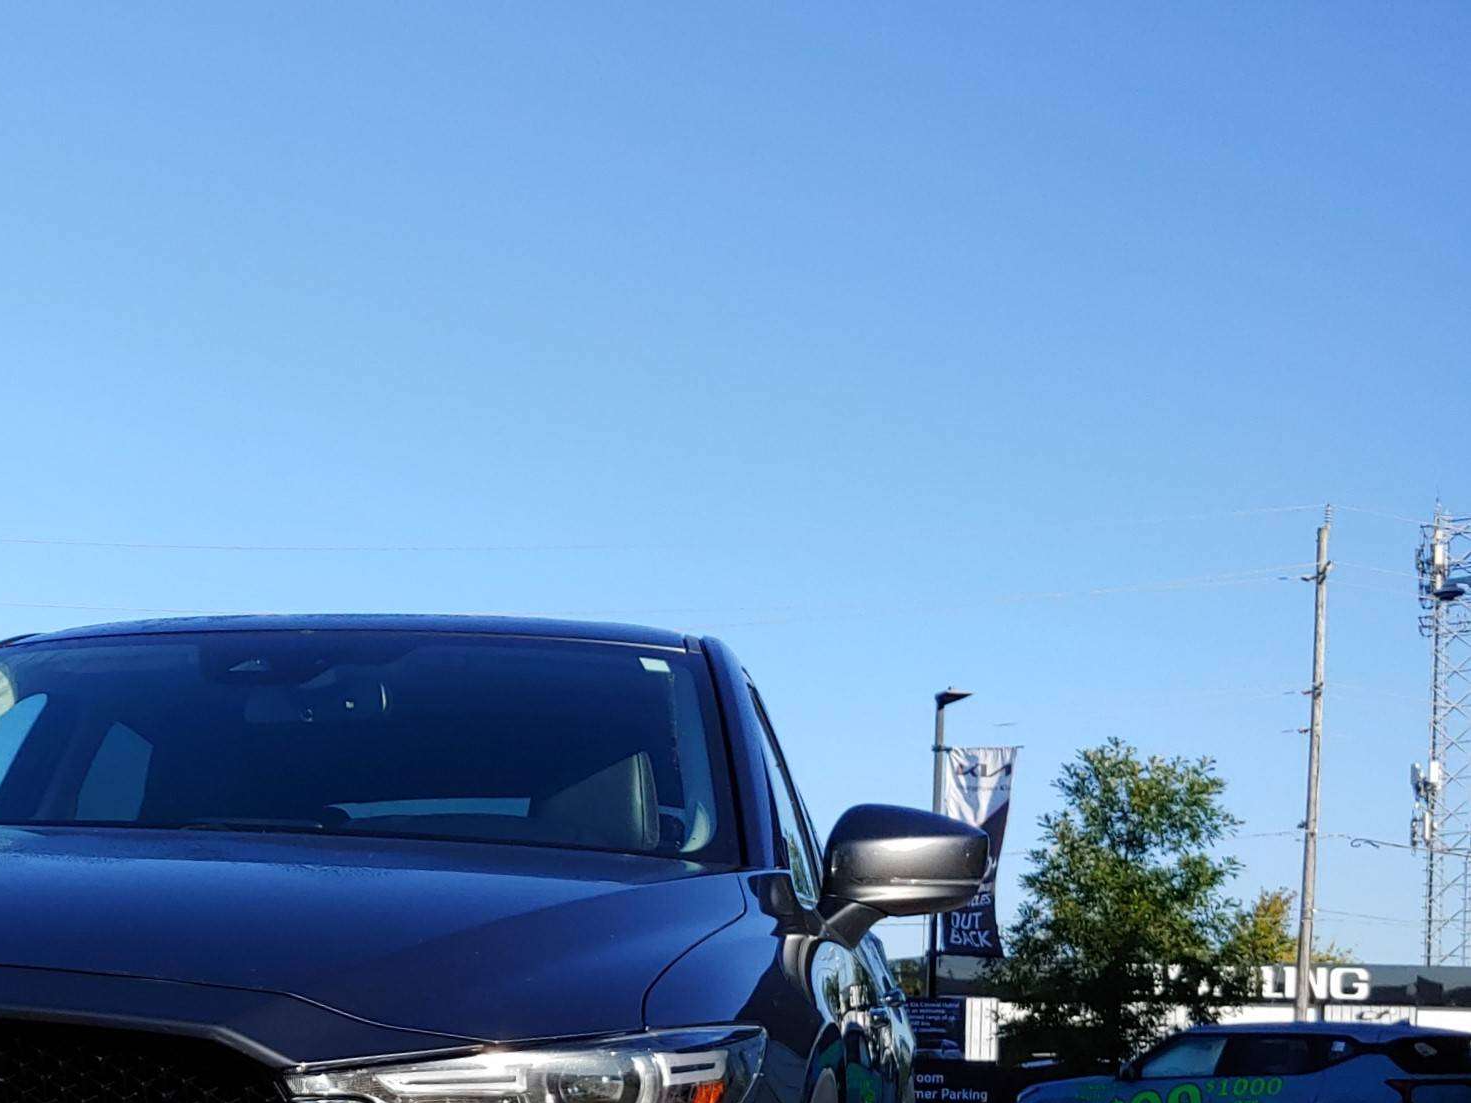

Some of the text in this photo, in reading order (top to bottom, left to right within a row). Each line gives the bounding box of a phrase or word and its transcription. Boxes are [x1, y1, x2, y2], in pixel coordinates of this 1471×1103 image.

[951, 912, 982, 929] OUT
[950, 929, 992, 948] BACK
[916, 1073, 944, 1083] oom
[941, 1087, 989, 1103] Parking
[1206, 1077, 1284, 1097] $1000
